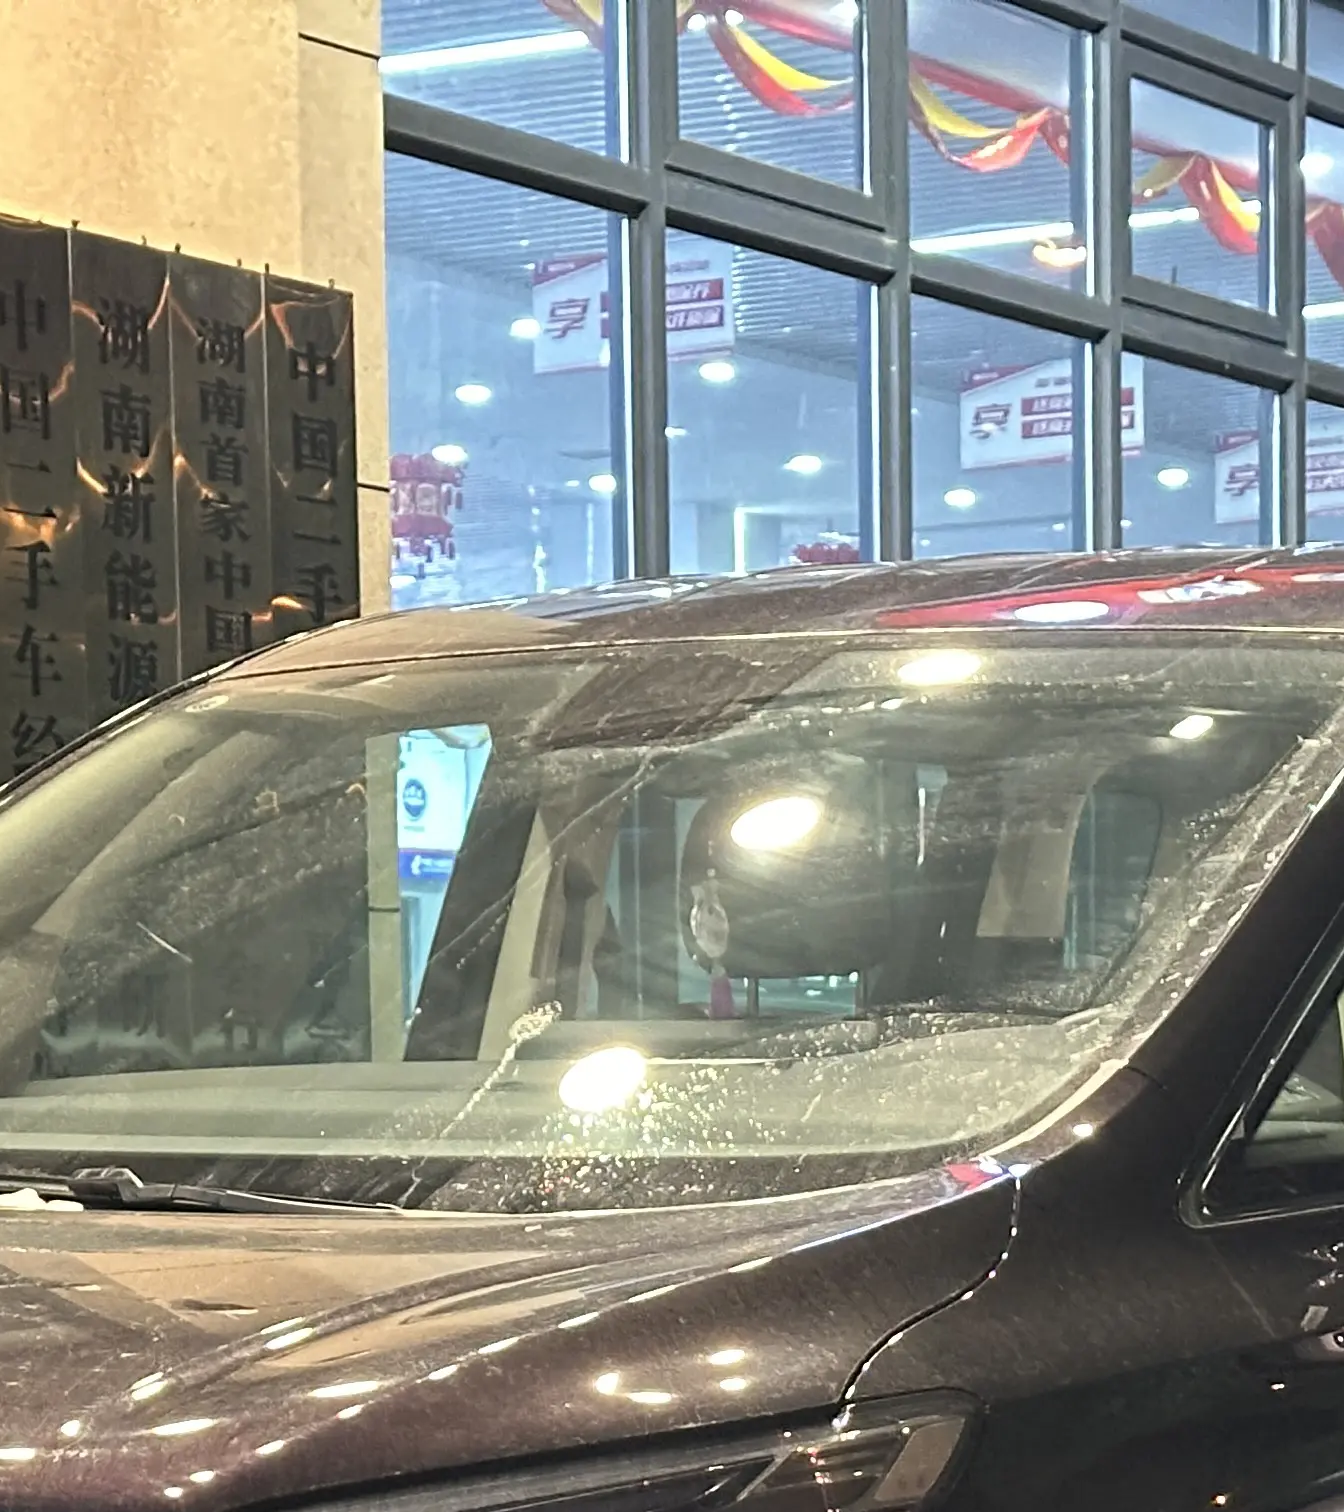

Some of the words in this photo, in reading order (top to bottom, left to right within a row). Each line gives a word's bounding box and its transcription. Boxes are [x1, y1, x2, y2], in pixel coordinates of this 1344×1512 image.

[98, 297, 158, 702] 湖南新能源
[196, 316, 253, 656] 湖南首家中国
[288, 341, 342, 624] 中国二手
